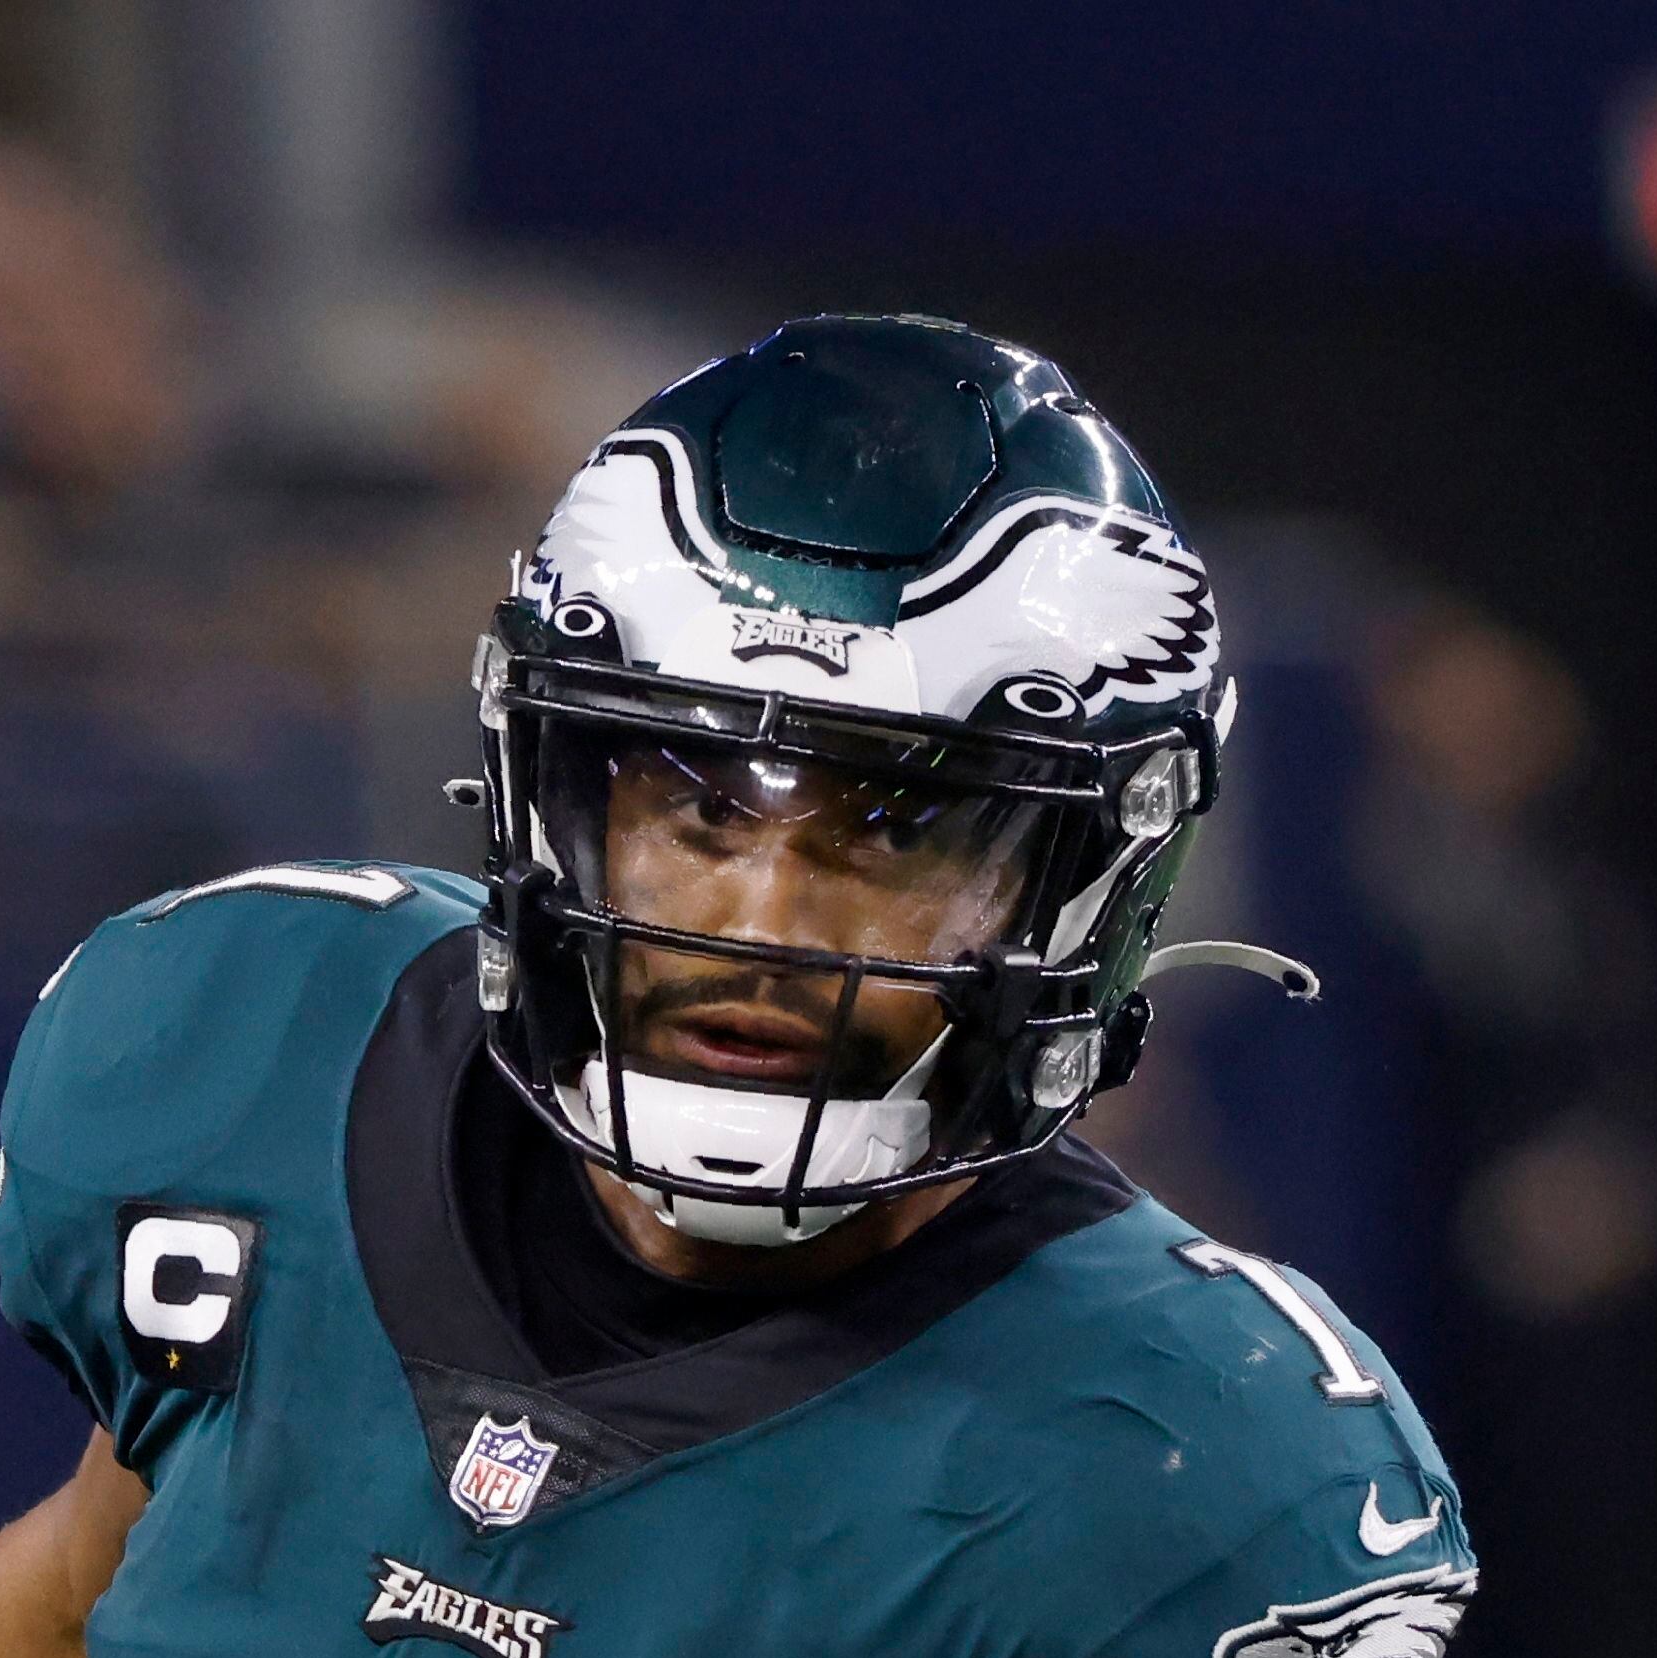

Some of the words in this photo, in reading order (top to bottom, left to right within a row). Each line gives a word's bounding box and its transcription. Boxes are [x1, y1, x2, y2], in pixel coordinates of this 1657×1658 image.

[731, 613, 859, 673] EAGLES
[123, 1216, 241, 1344] C
[1168, 1237, 1388, 1406] 1
[462, 1458, 525, 1512] NFL
